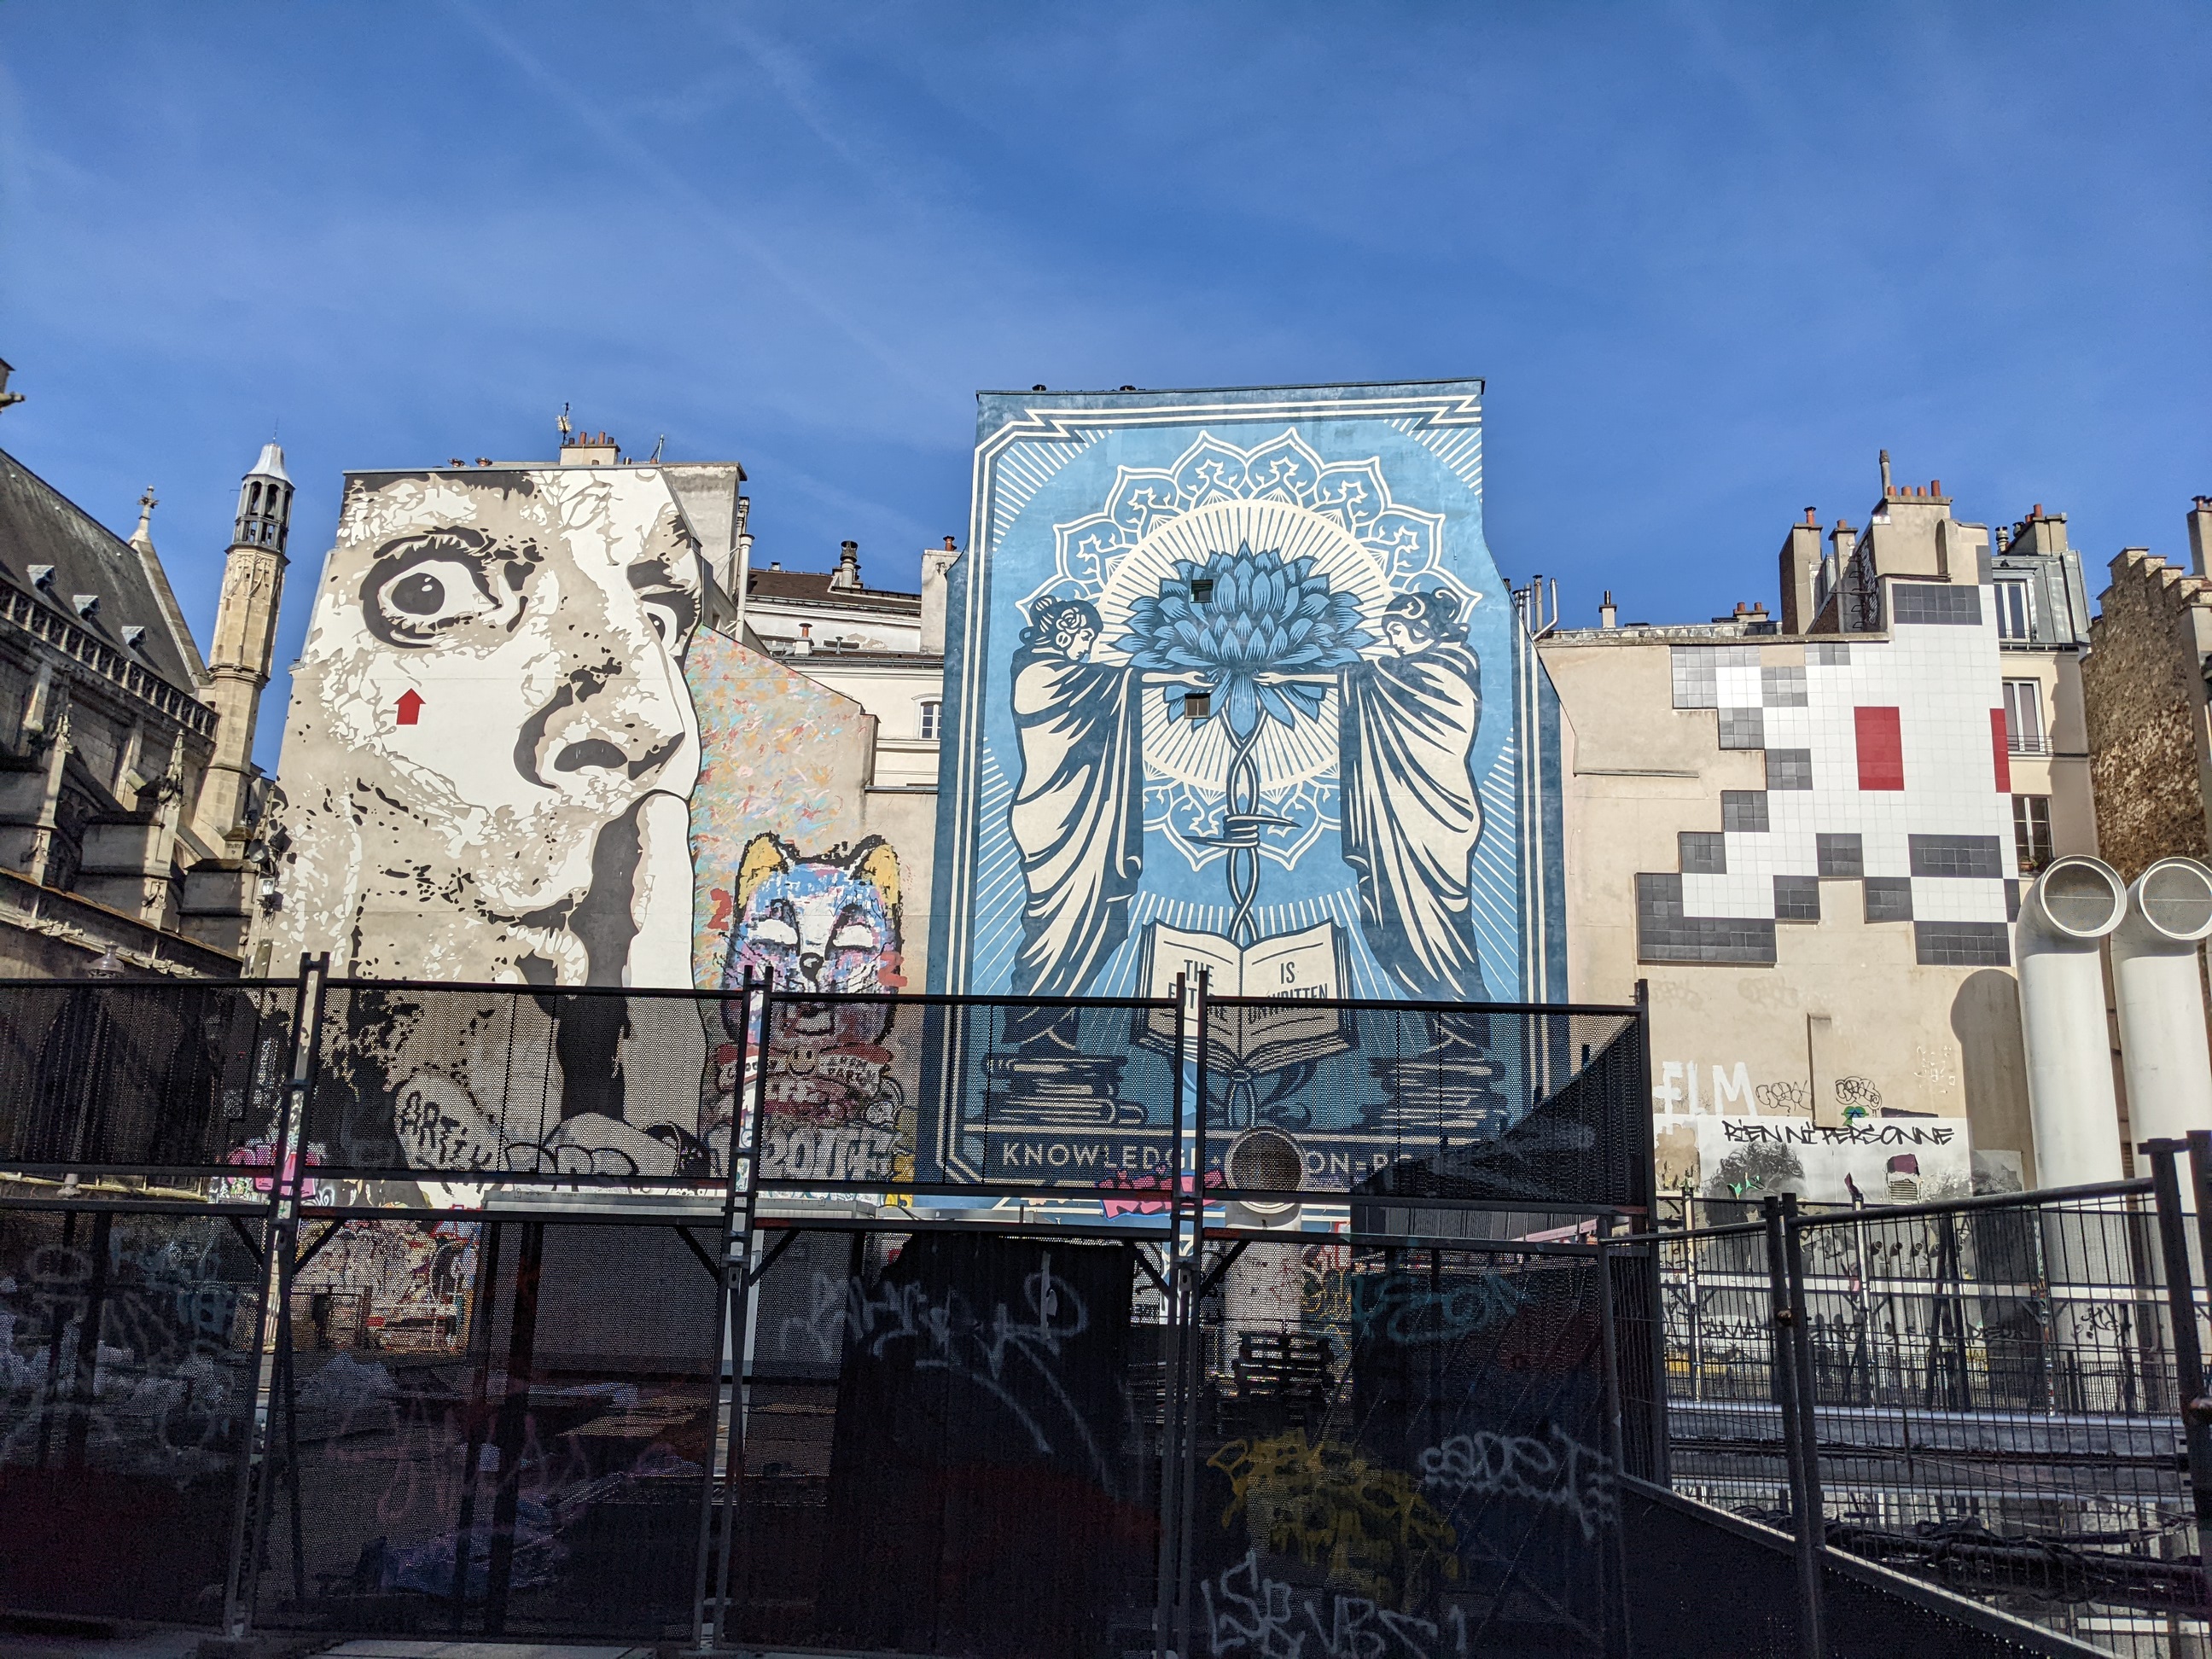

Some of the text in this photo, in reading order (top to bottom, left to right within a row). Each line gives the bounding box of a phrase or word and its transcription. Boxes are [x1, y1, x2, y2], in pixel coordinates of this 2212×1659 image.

[1184, 959, 1215, 987] THE
[1280, 961, 1295, 985] IS
[1167, 982, 1228, 1022] FTRE
[1722, 1119, 1955, 1146] RIEN NI PERSONNE
